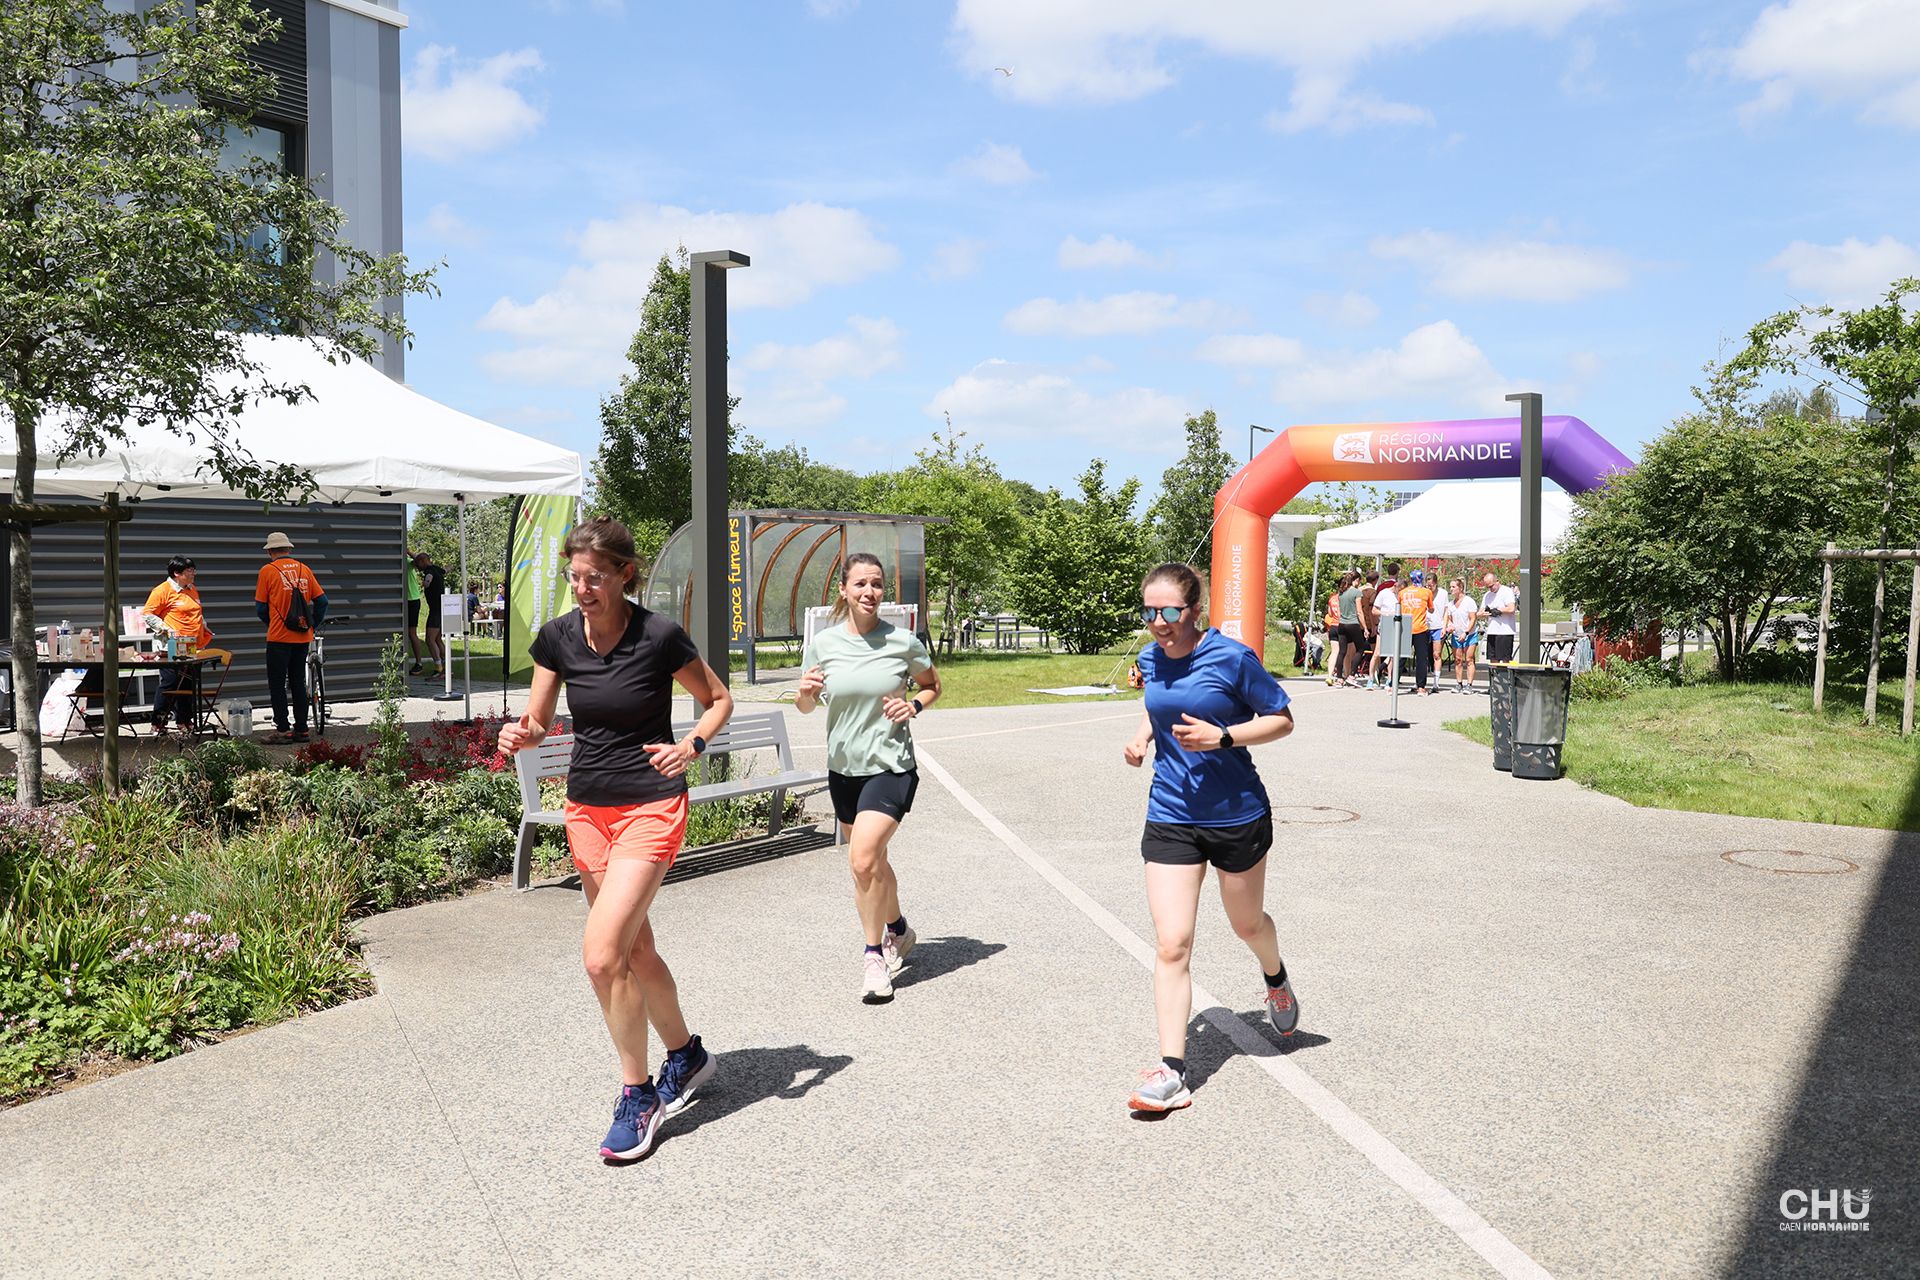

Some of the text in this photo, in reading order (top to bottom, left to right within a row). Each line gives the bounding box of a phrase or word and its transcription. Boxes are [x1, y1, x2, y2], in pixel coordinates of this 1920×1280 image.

[1379, 432, 1444, 446] RÉGION
[1379, 443, 1512, 463] NORMANDIE
[546, 536, 558, 622] ontre le Cancer
[728, 518, 742, 584] fumeurs
[1232, 544, 1242, 616] NORMANDIE
[531, 568, 542, 633] Normandie
